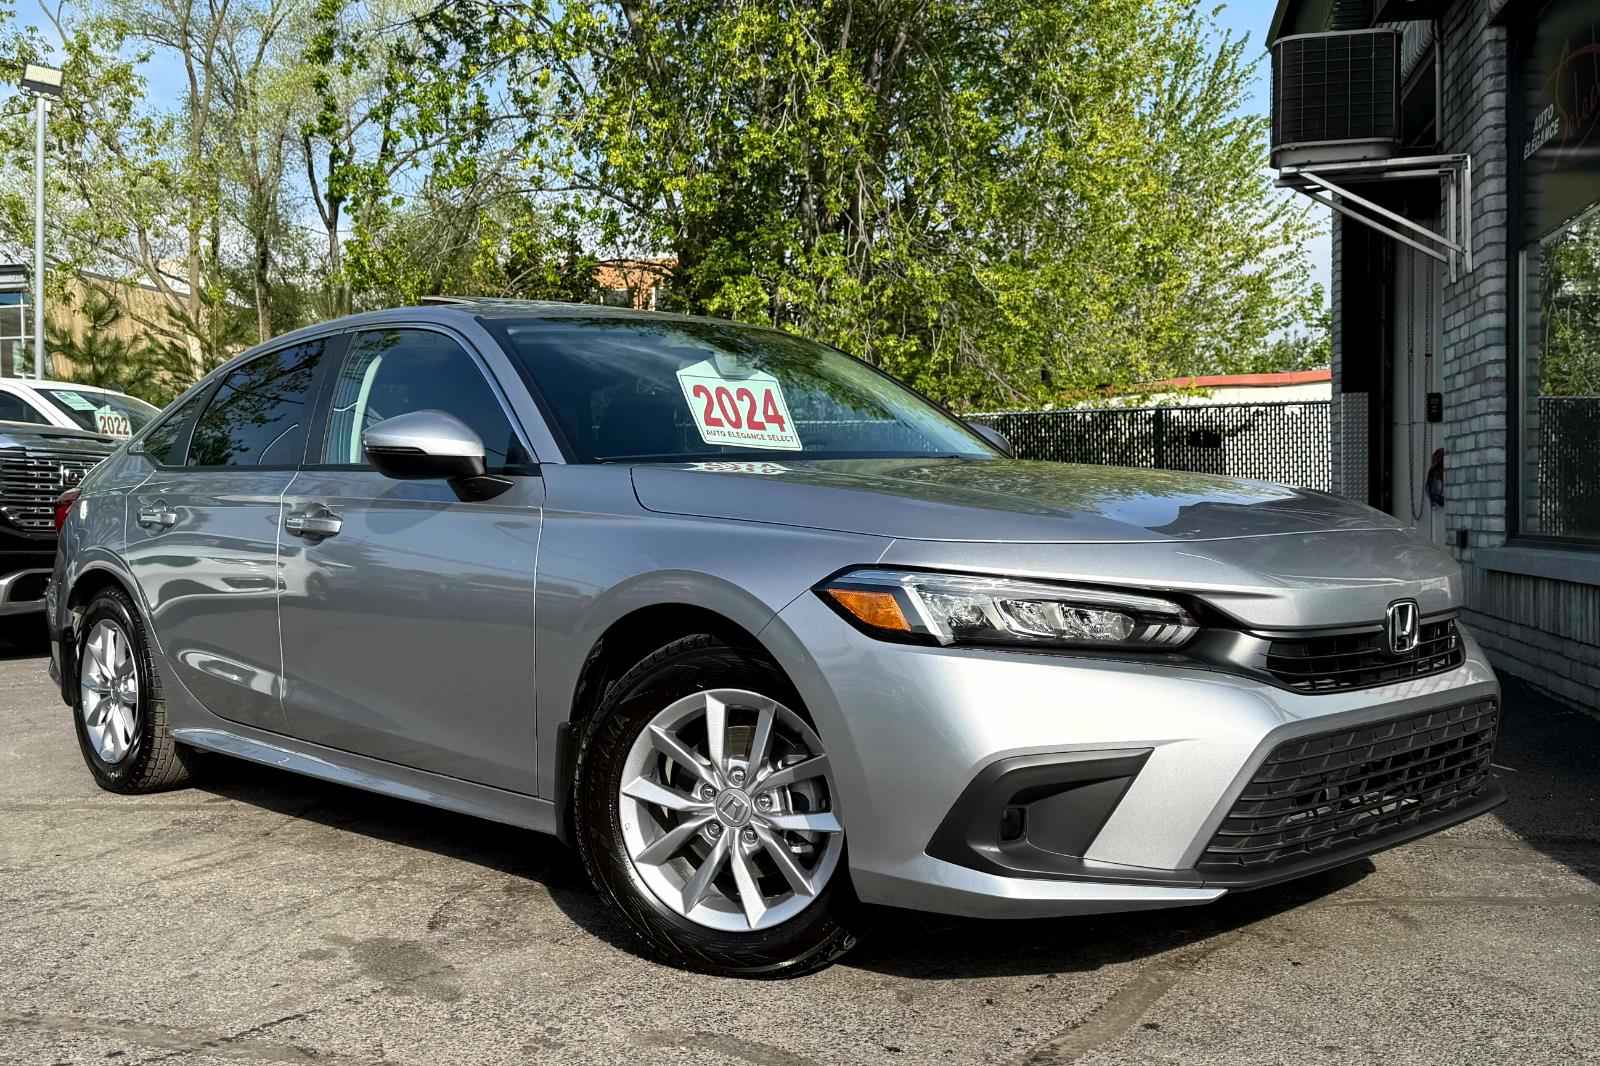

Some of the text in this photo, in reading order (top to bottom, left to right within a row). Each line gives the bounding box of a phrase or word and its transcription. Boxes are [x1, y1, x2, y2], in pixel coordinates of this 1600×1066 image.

[1533, 103, 1554, 134] AUTO
[692, 384, 786, 432] 2024
[99, 415, 130, 435] 2022
[706, 429, 726, 437] AUTO
[767, 434, 794, 443] SELECT
